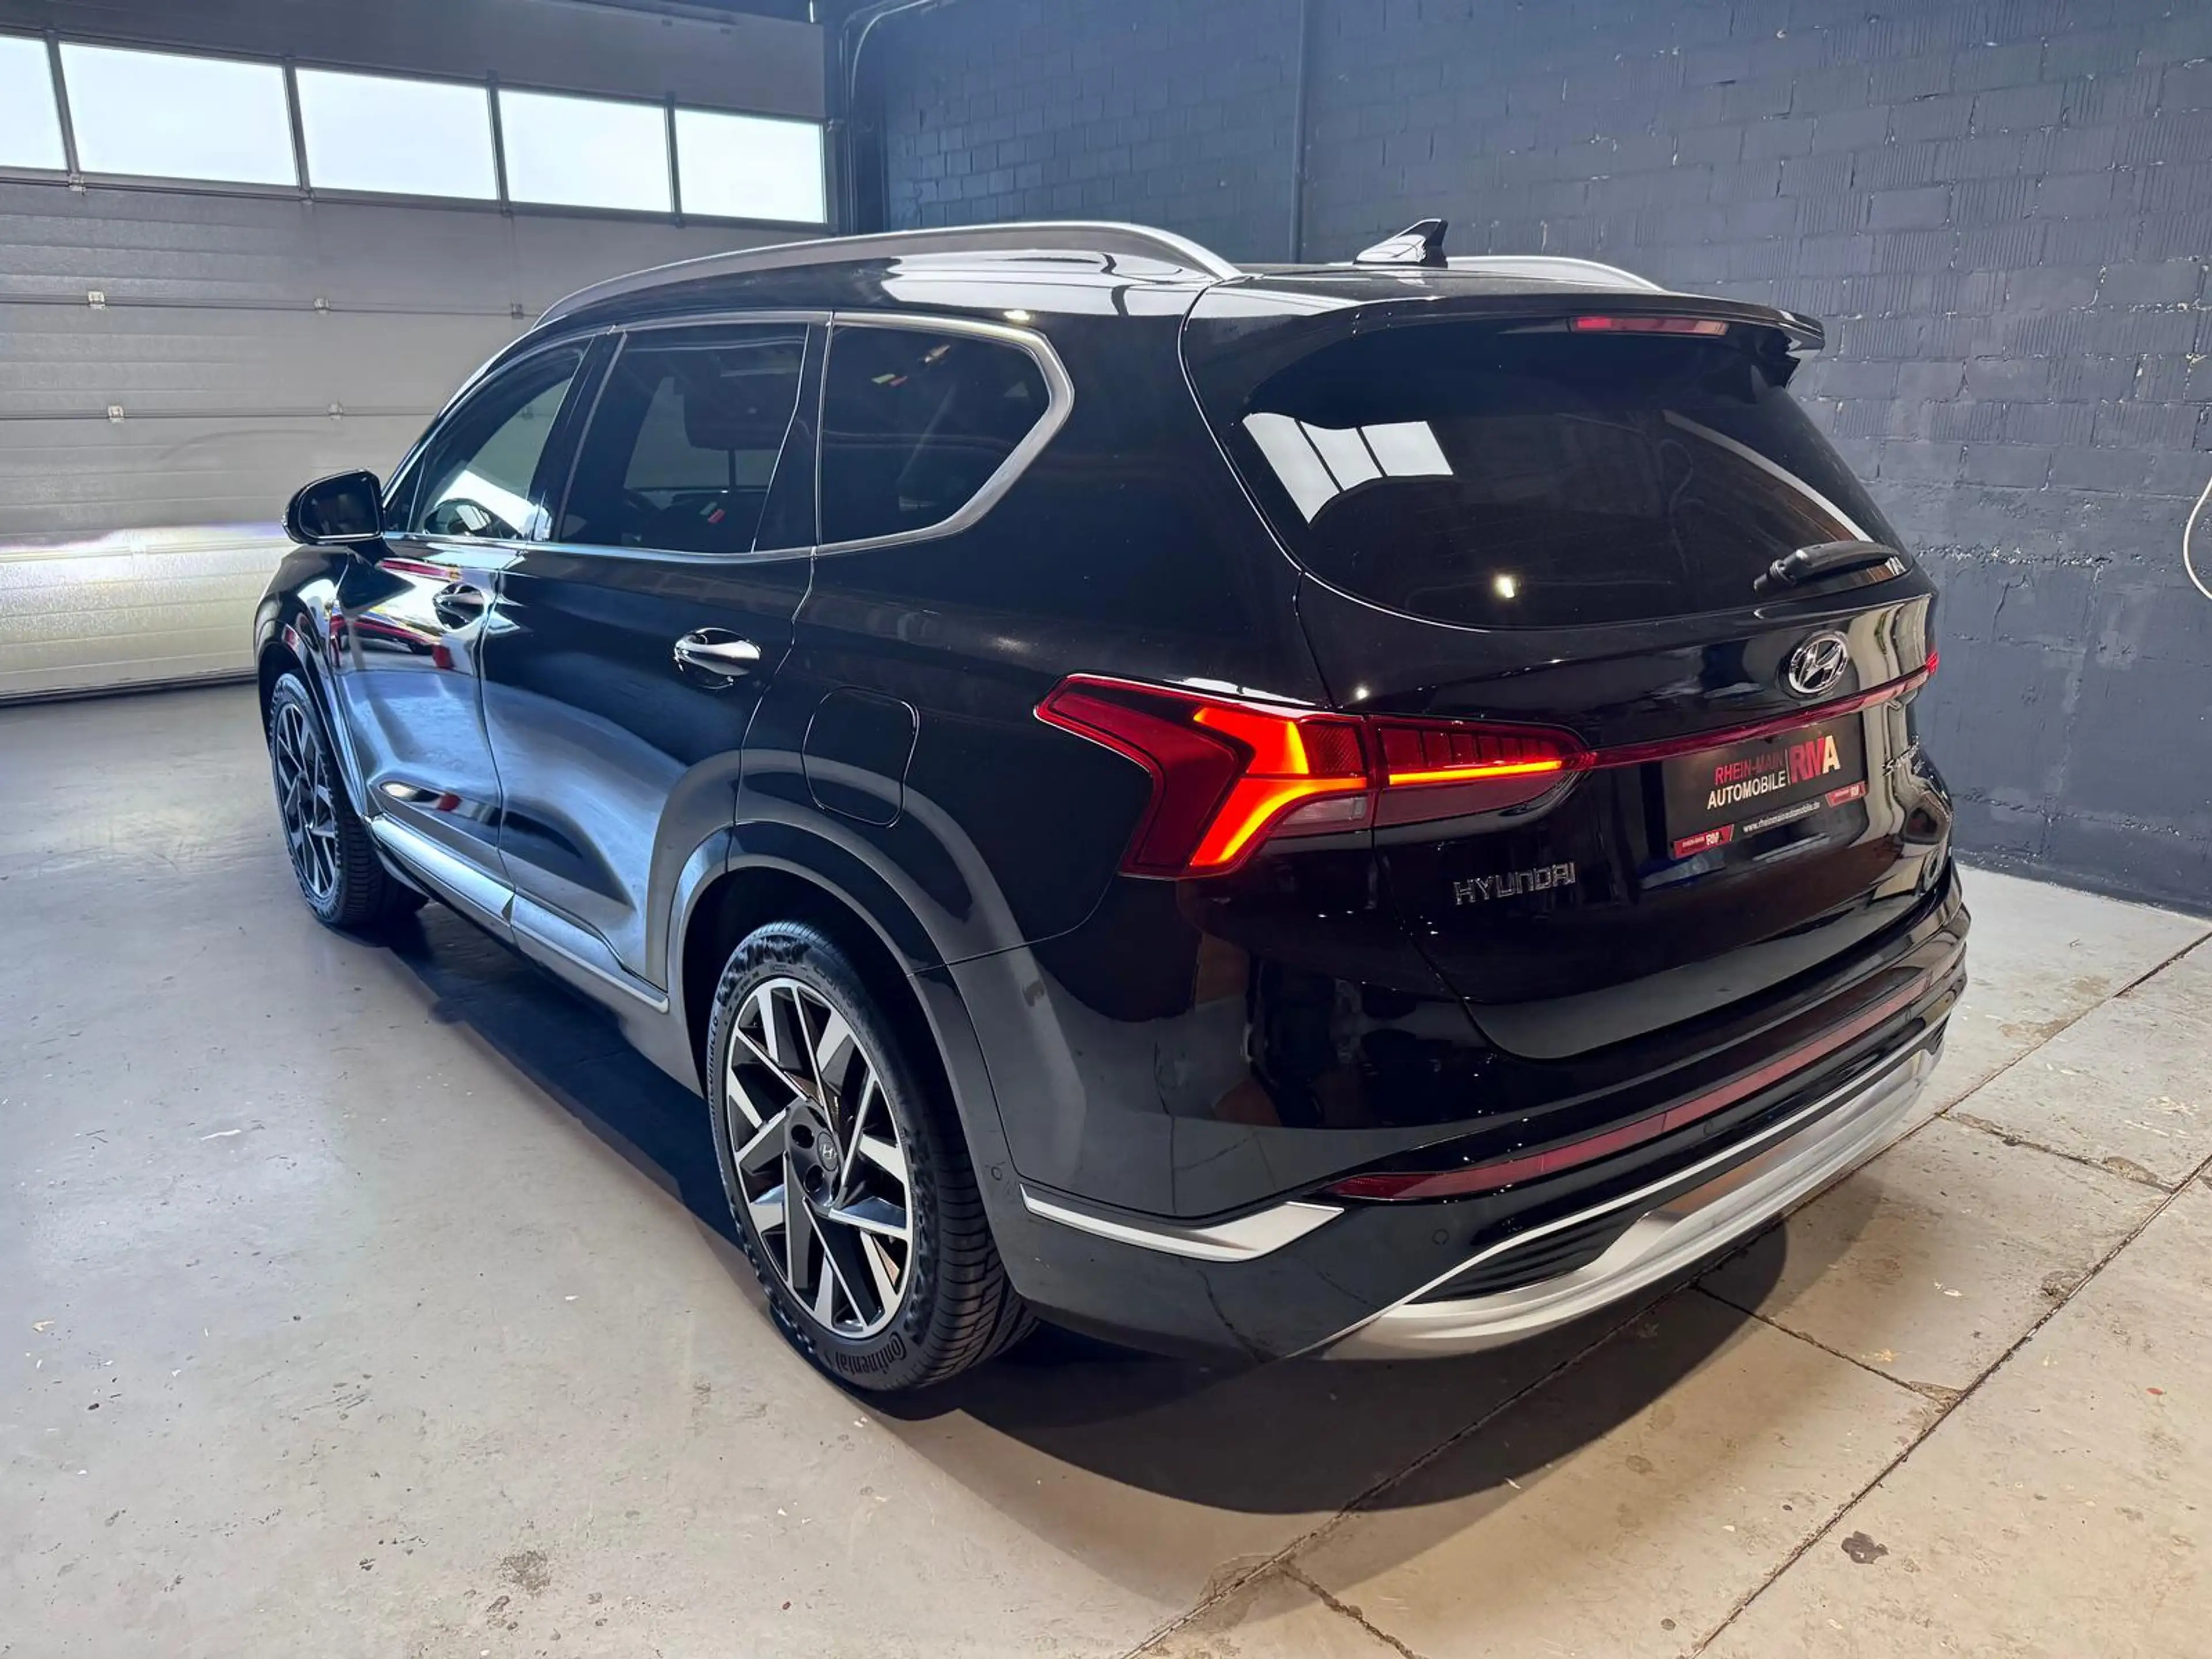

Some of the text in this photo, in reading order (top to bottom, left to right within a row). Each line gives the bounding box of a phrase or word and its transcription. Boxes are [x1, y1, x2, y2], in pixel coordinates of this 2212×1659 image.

[1714, 750, 1784, 786] RHEIN-MAIN
[1707, 770, 1786, 810] AUTOMOBILE
[1453, 862, 1577, 906] HYUNDAI
[835, 1331, 908, 1376] Continental
